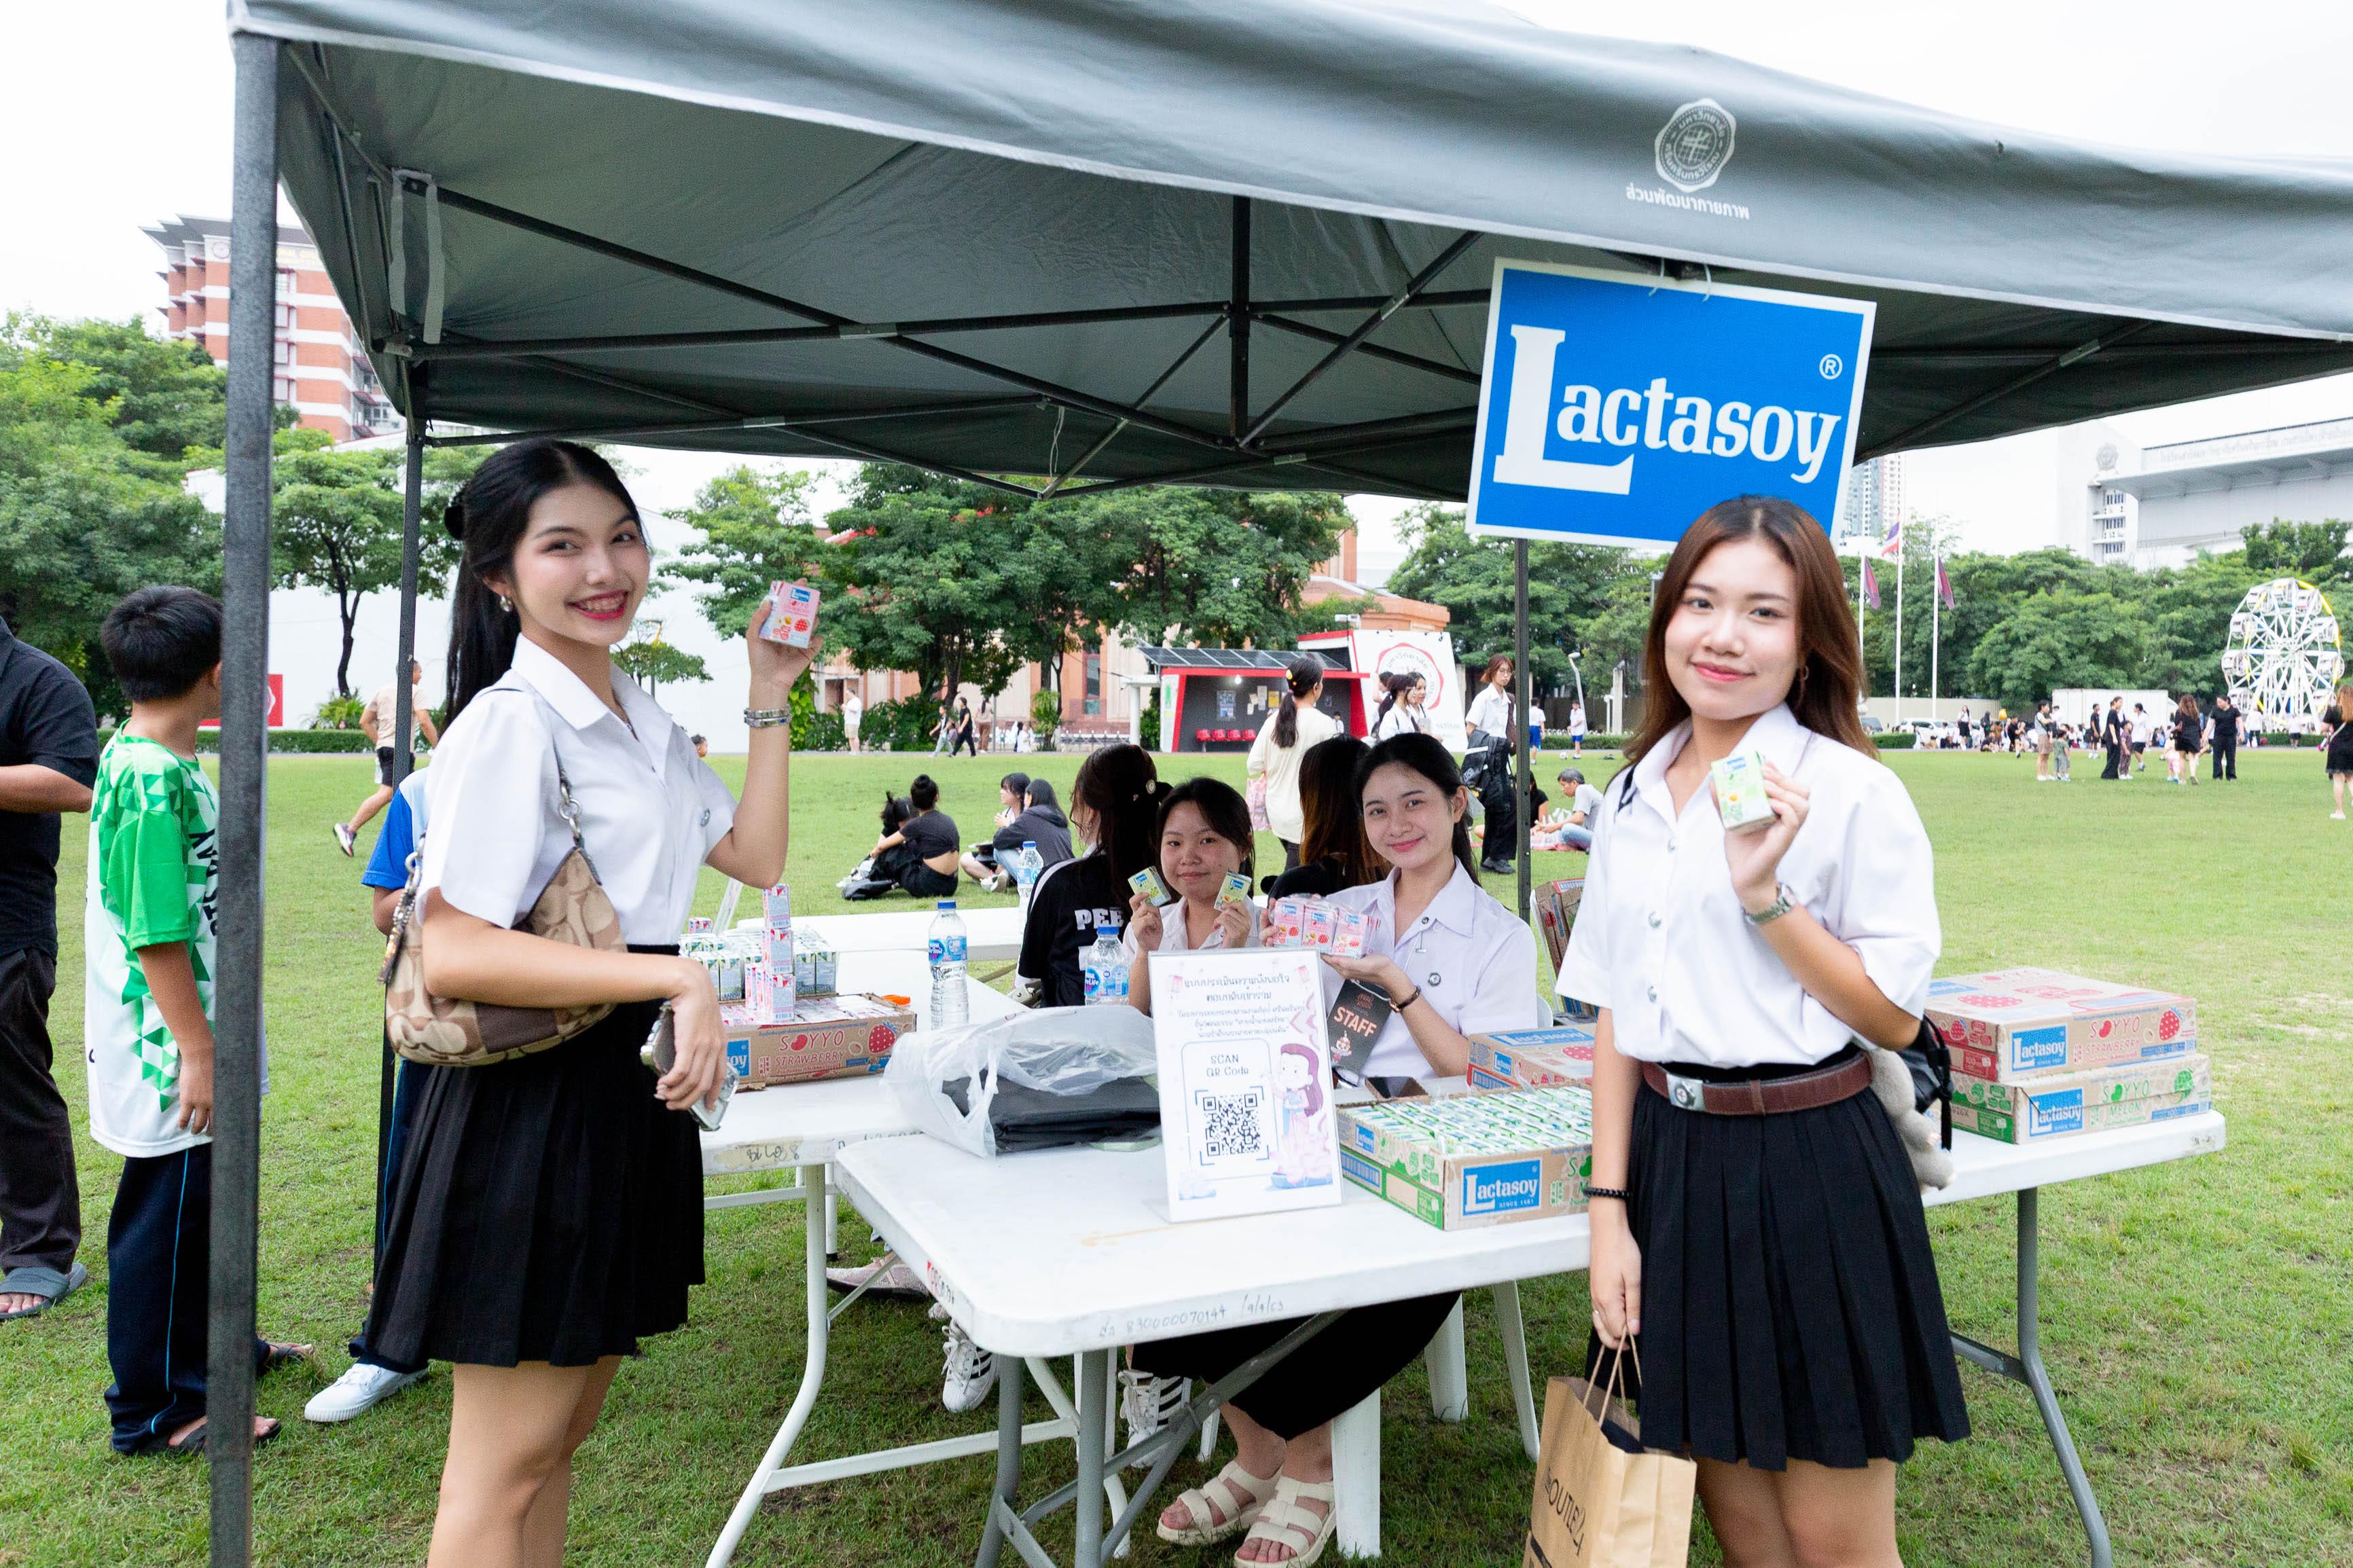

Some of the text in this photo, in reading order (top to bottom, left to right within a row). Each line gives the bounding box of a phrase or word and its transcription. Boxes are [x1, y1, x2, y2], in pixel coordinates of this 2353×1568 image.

[1626, 182, 1750, 219] ส่วนพัฒนากายภาพ
[1493, 324, 1842, 496] Lactasoy
[1333, 1006, 1378, 1037] STAFF
[775, 1050, 845, 1067] STRAWBERRY
[1210, 1055, 1239, 1064] SCAN
[2013, 1037, 2064, 1068] Lactasoy
[2086, 1037, 2141, 1055] STRAWBERRY
[1206, 1065, 1249, 1077] QR Code
[2031, 1101, 2082, 1134] Lactasoy
[1465, 1174, 1539, 1212] Lactasoy
